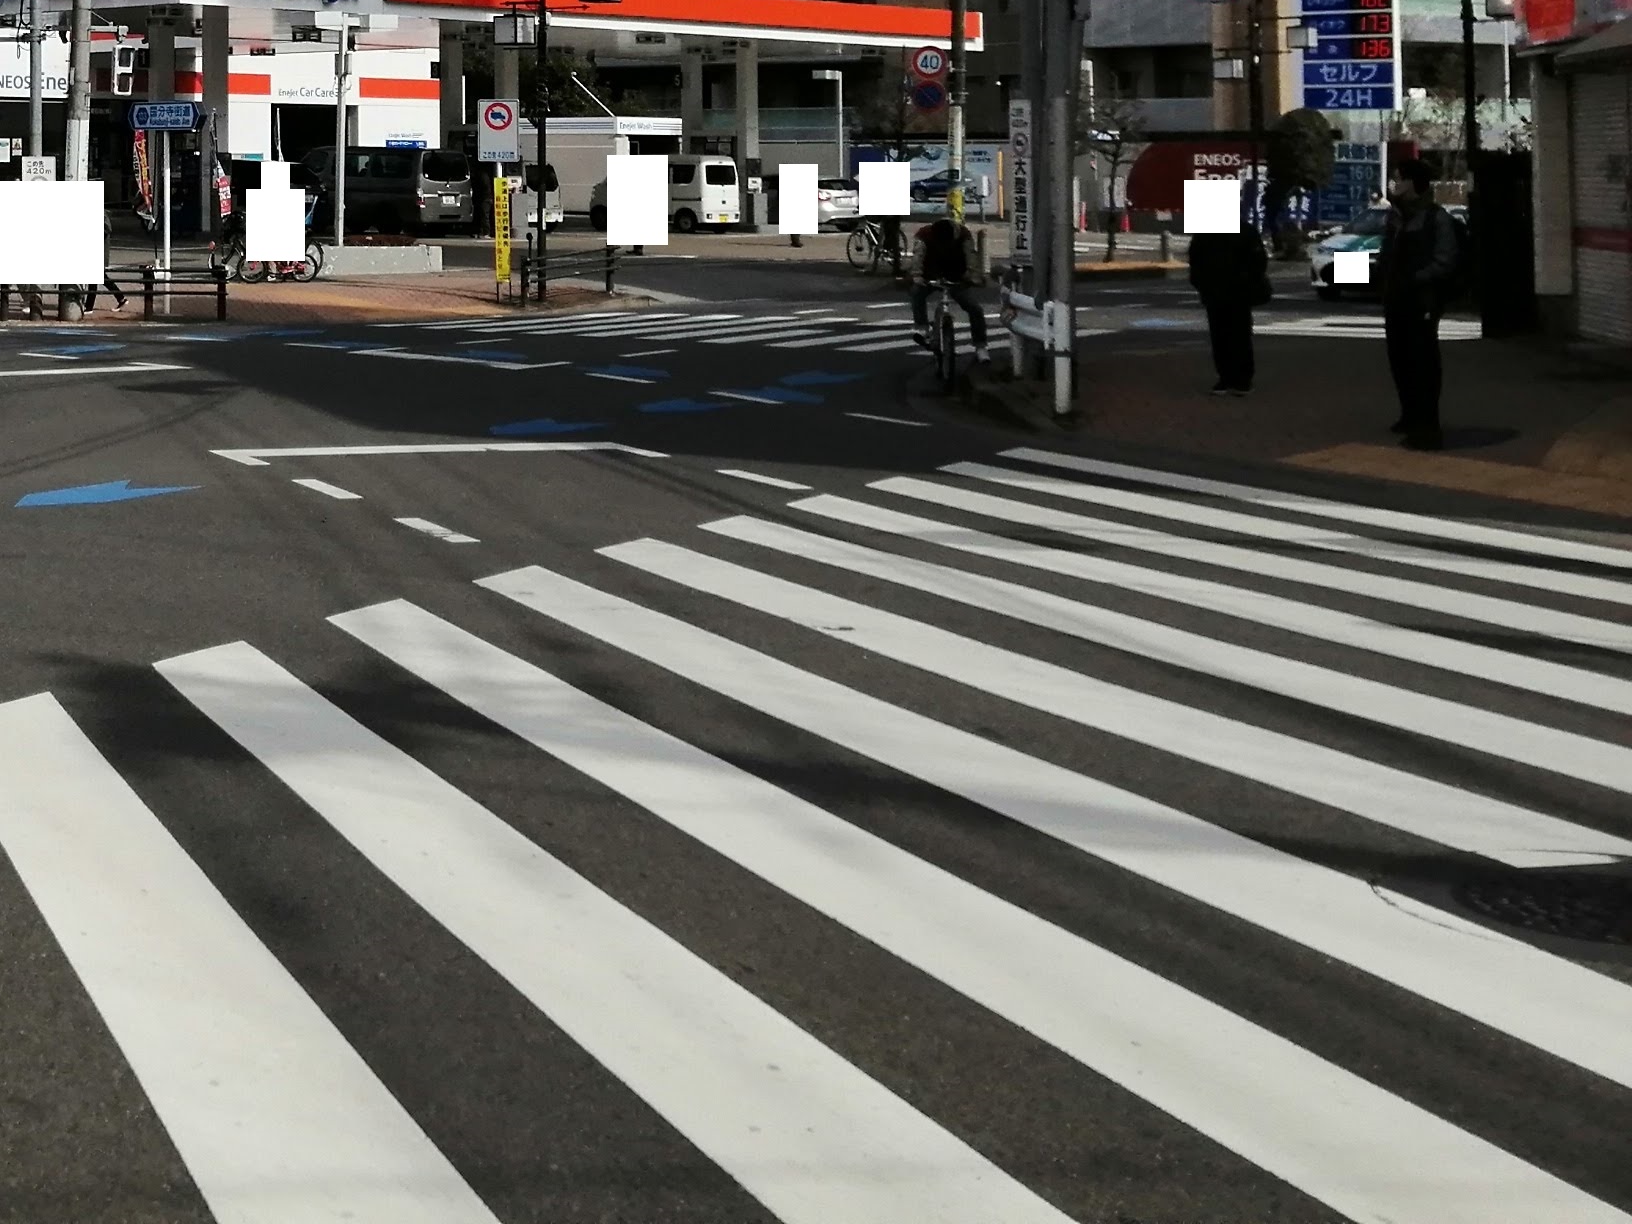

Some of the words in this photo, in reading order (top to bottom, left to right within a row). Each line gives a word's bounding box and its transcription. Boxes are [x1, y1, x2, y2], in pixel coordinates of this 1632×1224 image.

[1360, 14, 1390, 33] 173
[1360, 39, 1391, 58] 136
[919, 55, 940, 70] 40
[1319, 64, 1379, 83] セルフ
[299, 87, 314, 97] Car
[1325, 88, 1373, 107] 24H
[149, 105, 191, 118] 国分寺街道
[1193, 153, 1241, 167] ENEOS
